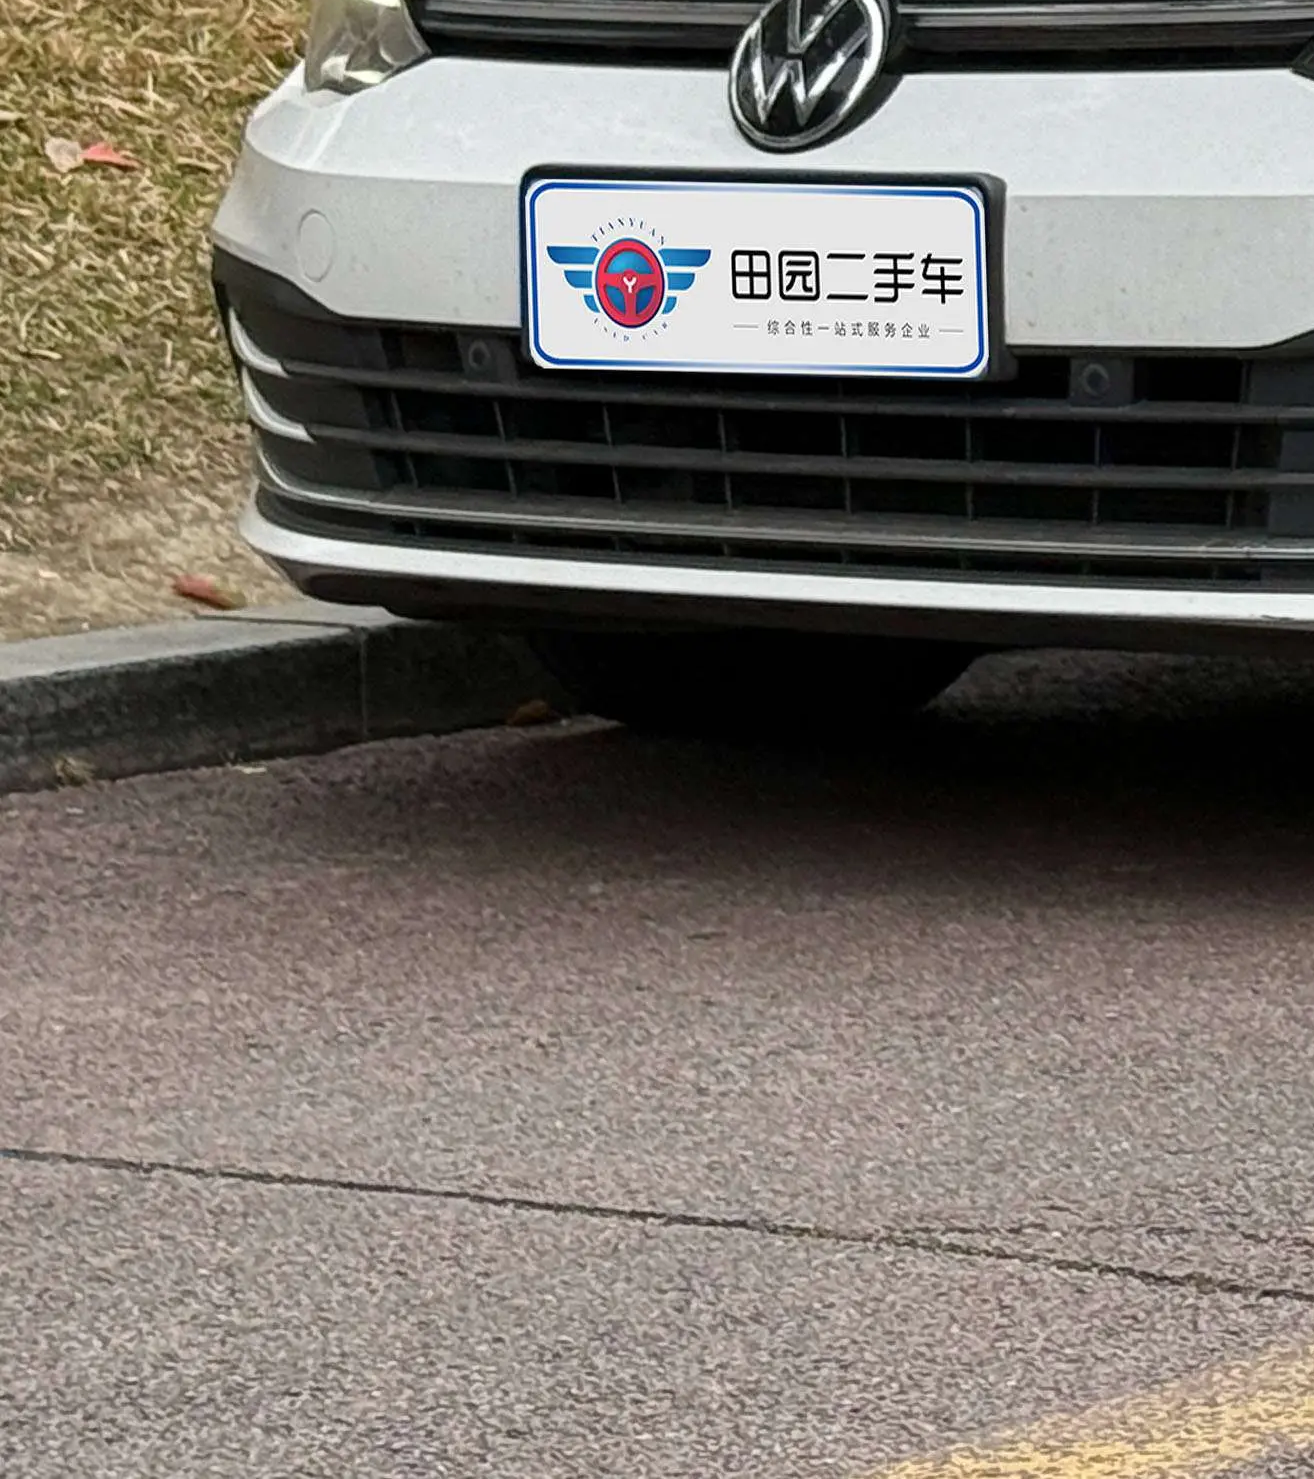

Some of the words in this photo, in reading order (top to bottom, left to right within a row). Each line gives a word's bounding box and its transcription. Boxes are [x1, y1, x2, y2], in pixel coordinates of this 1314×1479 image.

[731, 250, 964, 305] 田园二手车
[767, 319, 931, 339] 综合性一站式服务企业
